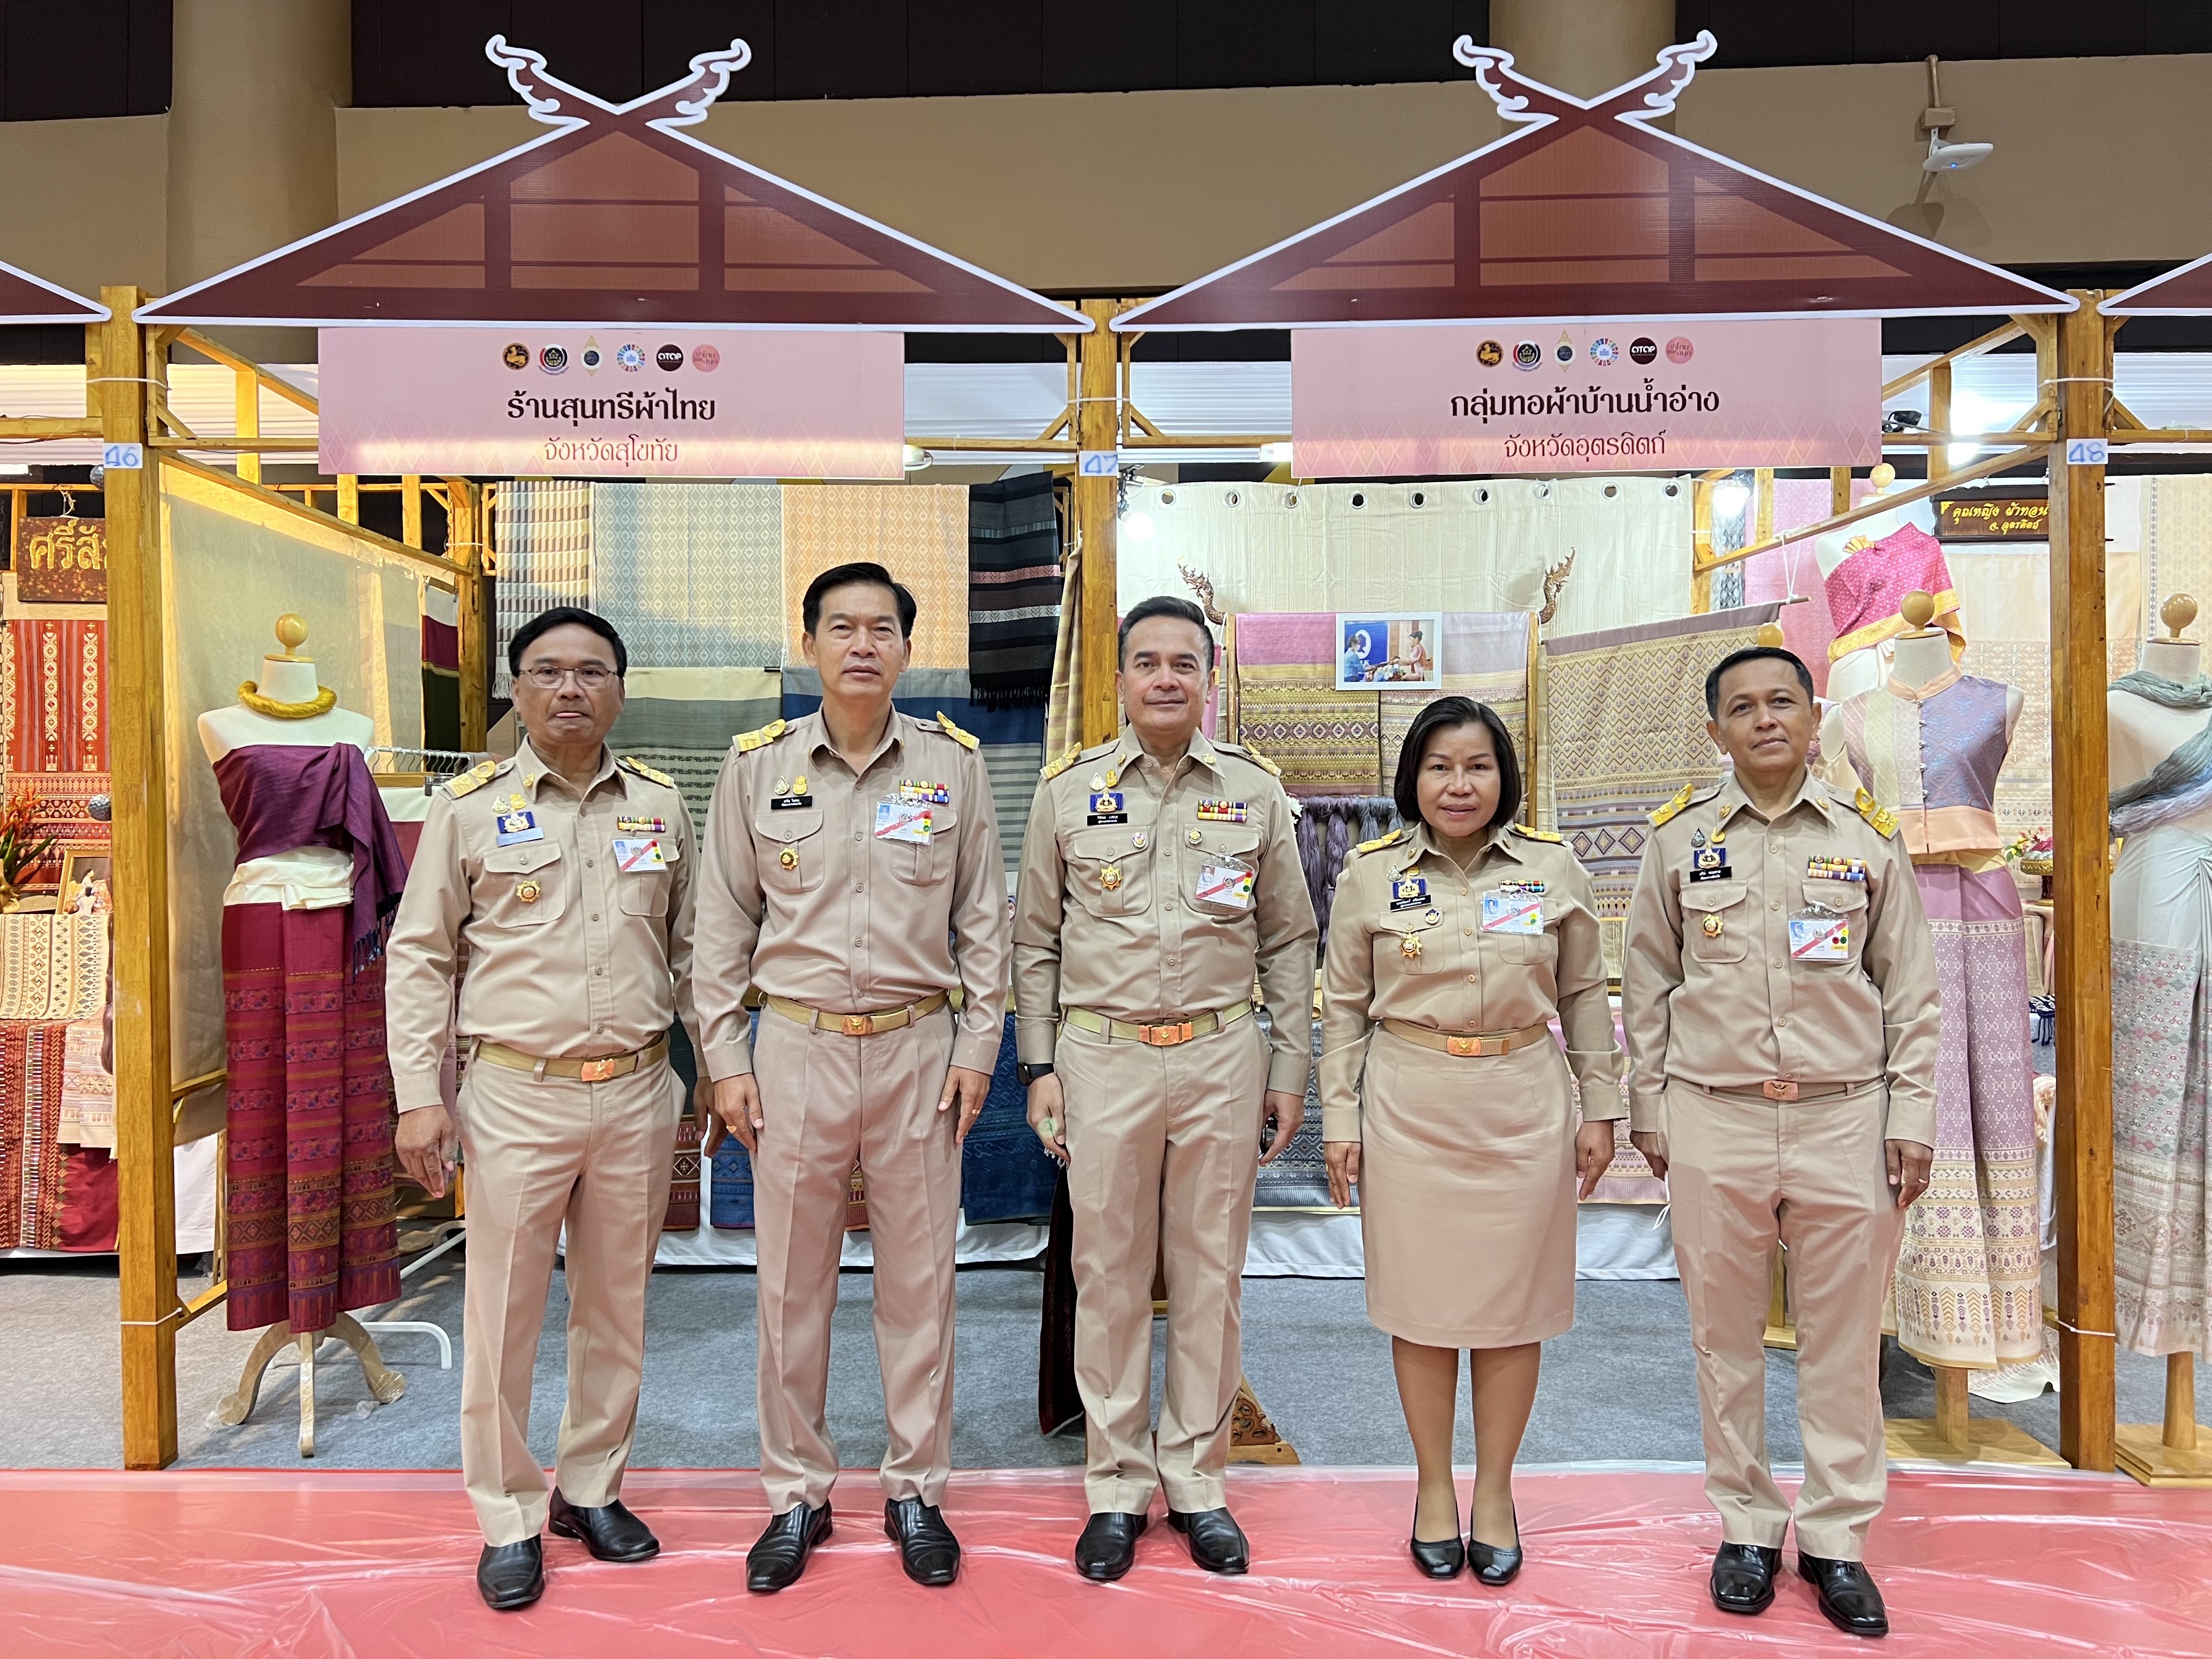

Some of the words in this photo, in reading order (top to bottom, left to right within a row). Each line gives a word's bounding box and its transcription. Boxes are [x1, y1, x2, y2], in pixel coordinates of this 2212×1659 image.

[507, 387, 715, 427] ร้านสุนทรีผ้าไทย
[1450, 377, 1720, 425] กลุ่มทอผ้าบ้านน้ำอ่าง
[544, 433, 678, 467] จังหวัดสุโขทัย
[1504, 429, 1667, 462] จังหวัดอุตรดิตถ์
[1952, 503, 2000, 526] คุณหญิง
[29, 518, 107, 571] ศรีสั
